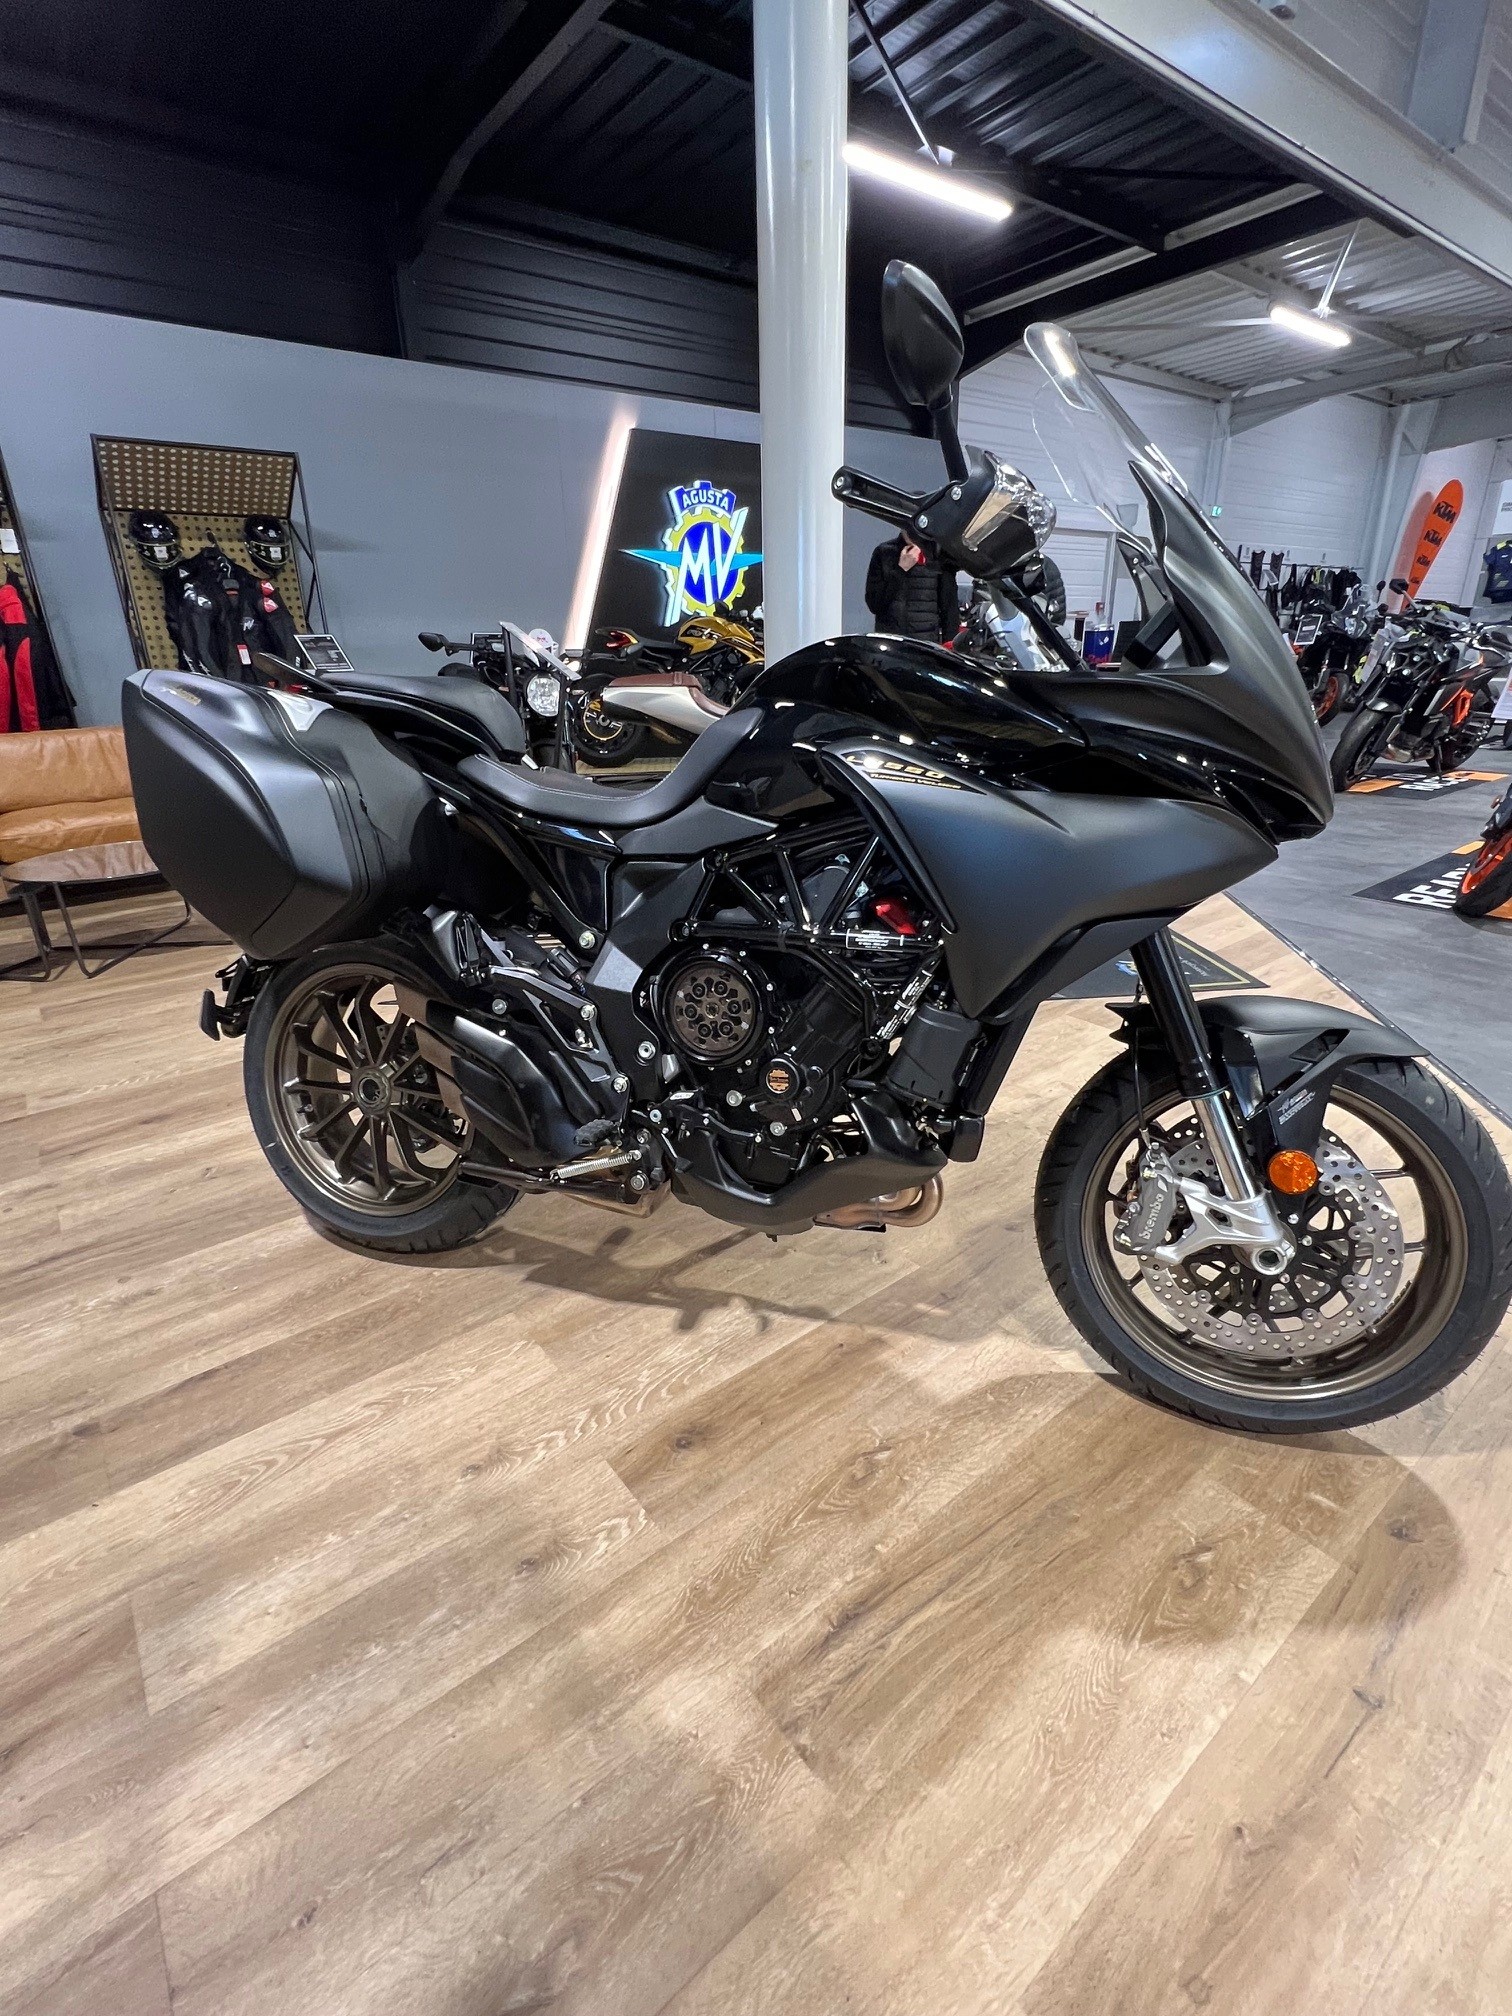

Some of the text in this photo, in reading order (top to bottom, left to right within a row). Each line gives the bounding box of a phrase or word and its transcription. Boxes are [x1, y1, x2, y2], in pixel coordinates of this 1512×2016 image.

[682, 489, 729, 511] AGUSTA
[1433, 501, 1457, 524] KTM
[1423, 529, 1443, 548] KTM
[668, 507, 749, 627] MV
[1138, 1193, 1164, 1240] brembo
